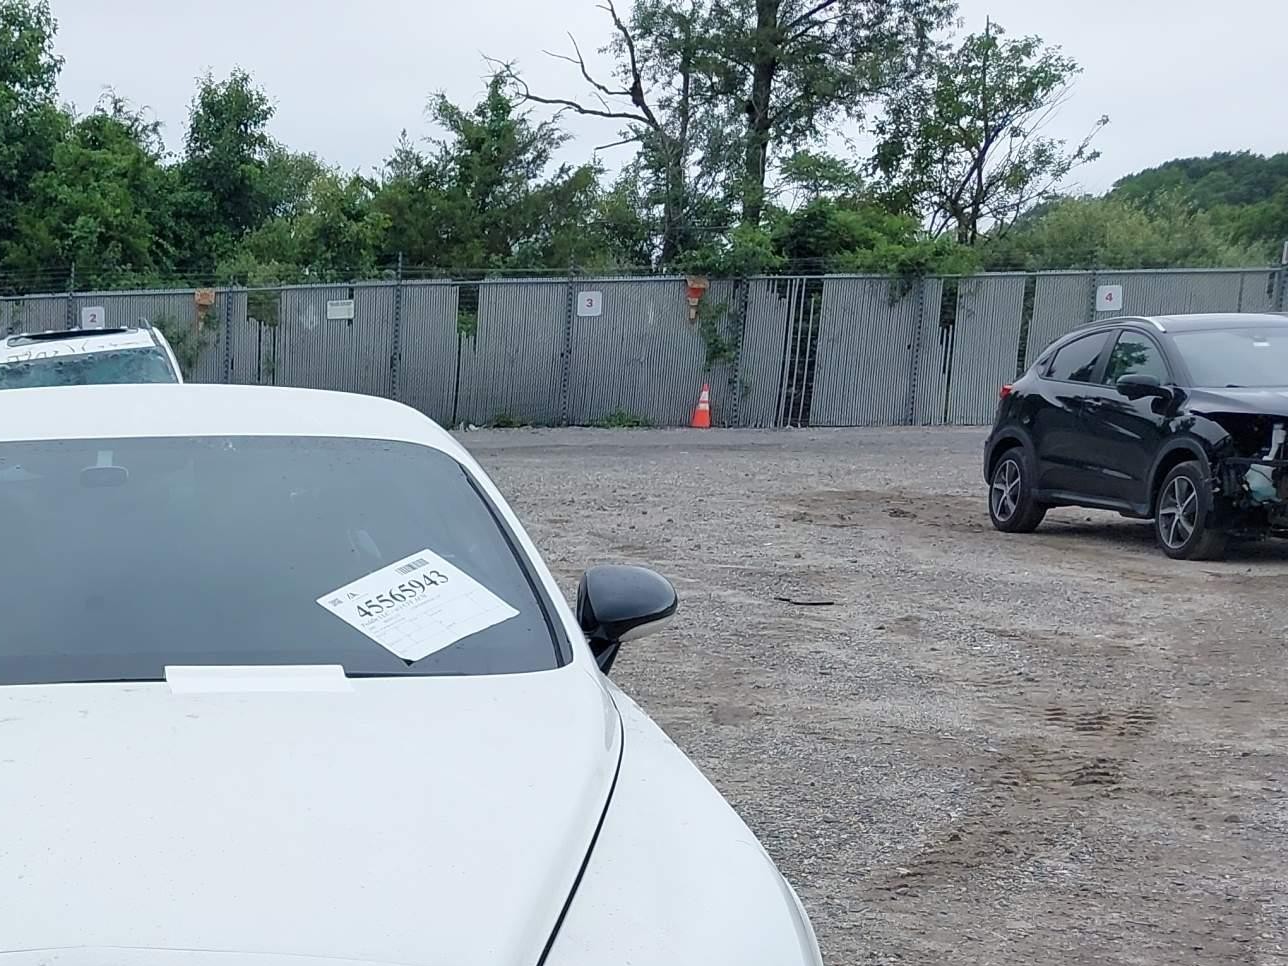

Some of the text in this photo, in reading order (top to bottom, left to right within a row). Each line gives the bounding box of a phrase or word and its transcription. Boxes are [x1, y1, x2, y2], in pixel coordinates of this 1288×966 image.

[1105, 292, 1113, 302] 4
[586, 298, 593, 308] 3
[89, 313, 97, 323] 2
[357, 569, 449, 618] 45565943
